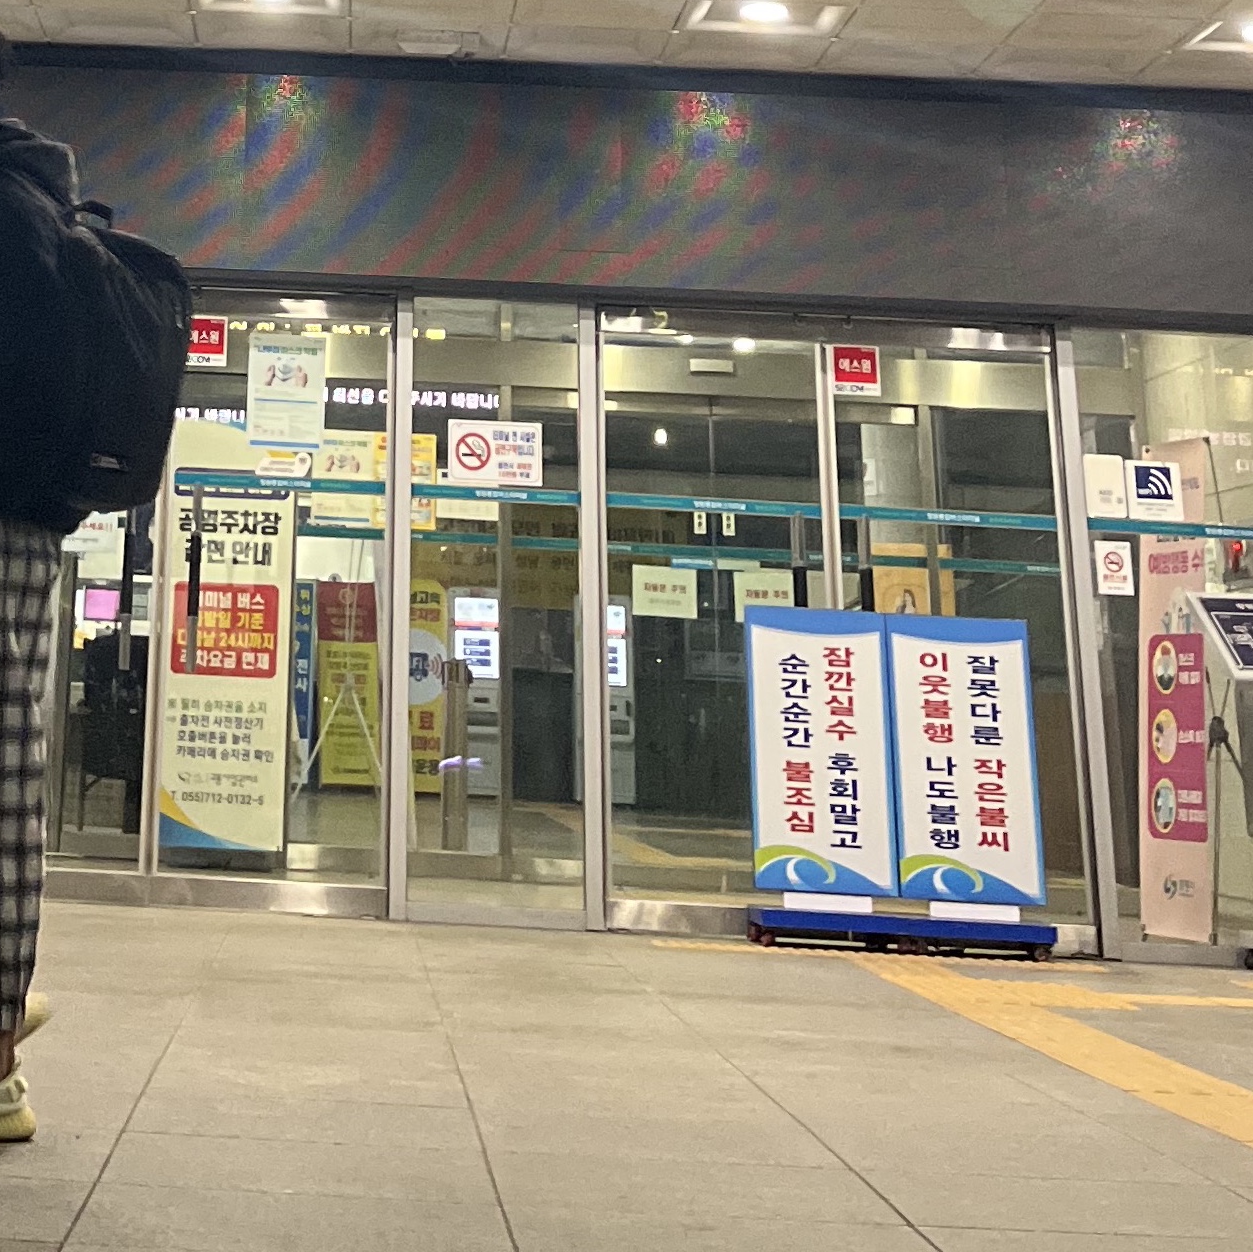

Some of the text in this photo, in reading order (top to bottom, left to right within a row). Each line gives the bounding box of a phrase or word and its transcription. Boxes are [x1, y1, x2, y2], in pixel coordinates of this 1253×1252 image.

[838, 358, 872, 374] 에스원
[179, 508, 282, 535] 공영주차장
[232, 541, 272, 566] 안내
[237, 592, 265, 609] 버스
[237, 612, 264, 630] 기준
[219, 632, 275, 650] 24시까지
[242, 651, 270, 670] 면제
[213, 715, 264, 731] 사전정산기
[177, 730, 228, 745] 호출버튼을
[778, 653, 816, 834] 순간순간 불조심
[822, 647, 863, 849] 잠깐실수 후회말고
[918, 652, 961, 850] 이웃불행 나도불행
[966, 655, 1010, 853] 잘못다룬 작은불씨
